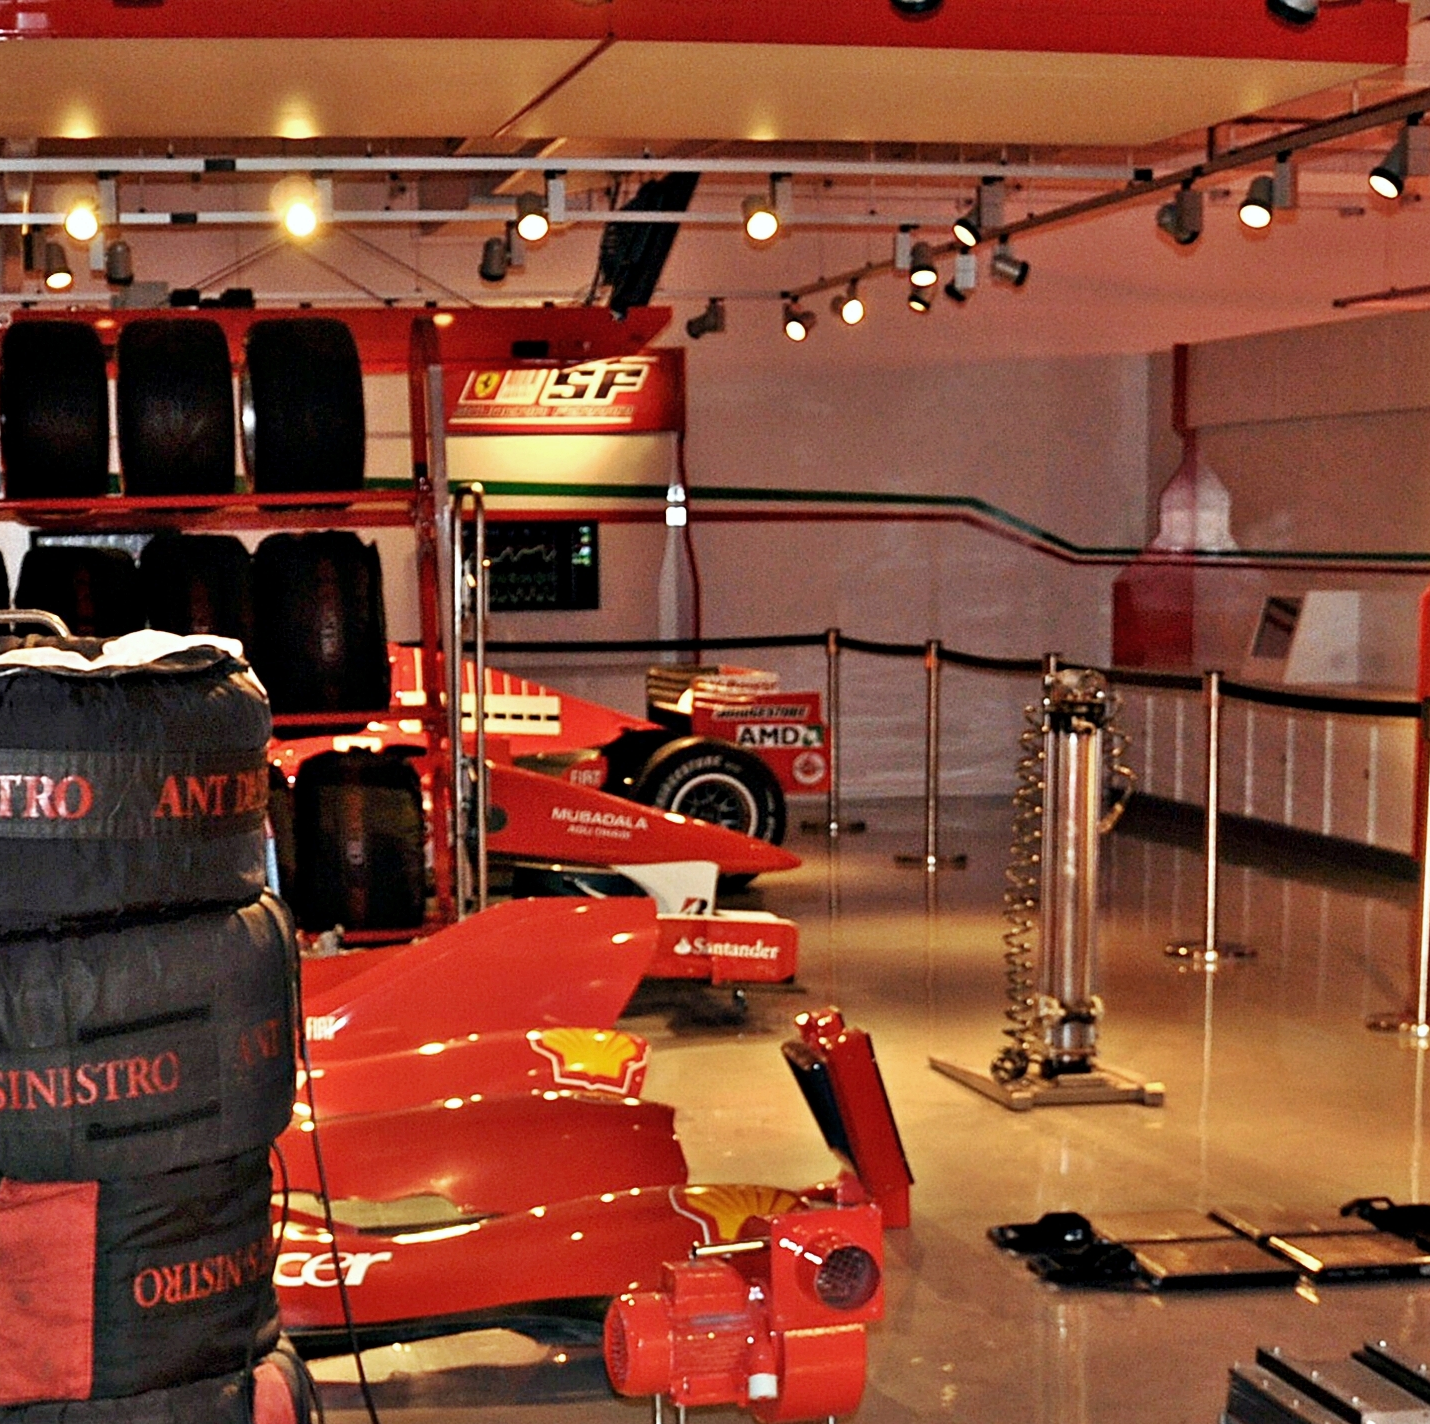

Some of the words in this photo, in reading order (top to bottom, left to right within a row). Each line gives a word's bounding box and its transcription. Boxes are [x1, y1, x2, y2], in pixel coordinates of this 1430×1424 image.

[545, 367, 647, 402] SF
[737, 726, 800, 745] AMD
[154, 774, 230, 818] ANT
[551, 806, 649, 831] MUBADALA
[692, 935, 780, 961] Santander
